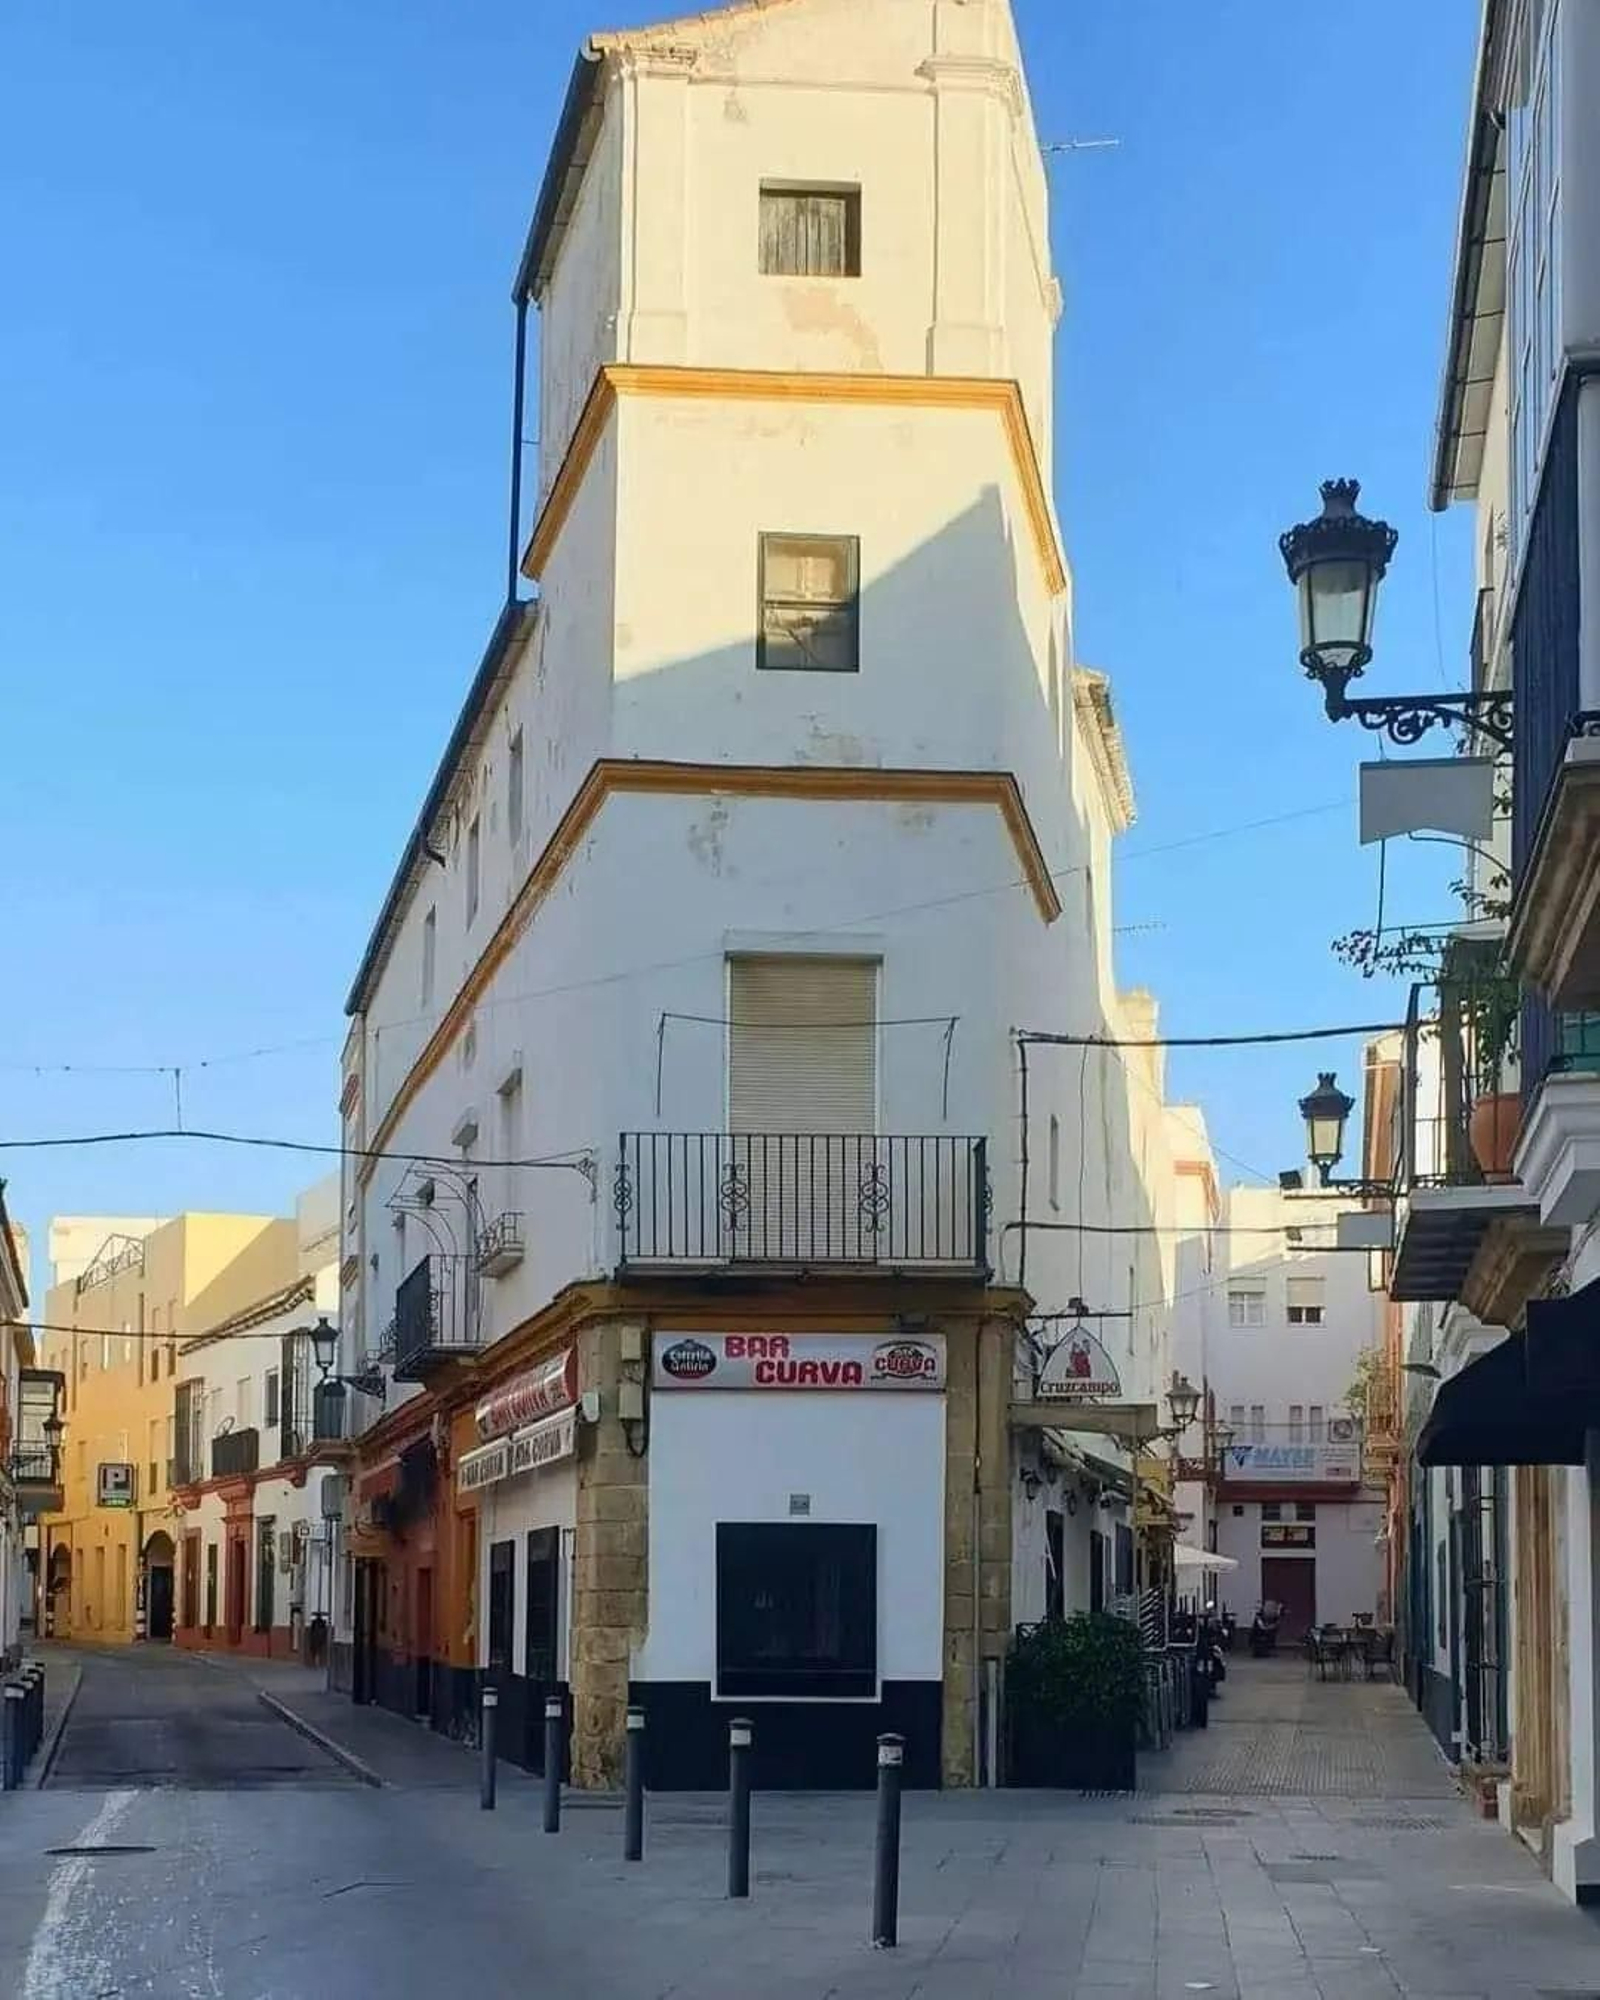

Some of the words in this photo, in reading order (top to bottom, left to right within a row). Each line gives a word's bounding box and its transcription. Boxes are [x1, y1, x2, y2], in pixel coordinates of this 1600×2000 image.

[725, 1336, 790, 1358] BAR
[756, 1362, 862, 1385] CURVA
[875, 1357, 935, 1372] CURVA
[1041, 1382, 1118, 1396] Cruzcampo
[532, 1429, 562, 1464] CURVA
